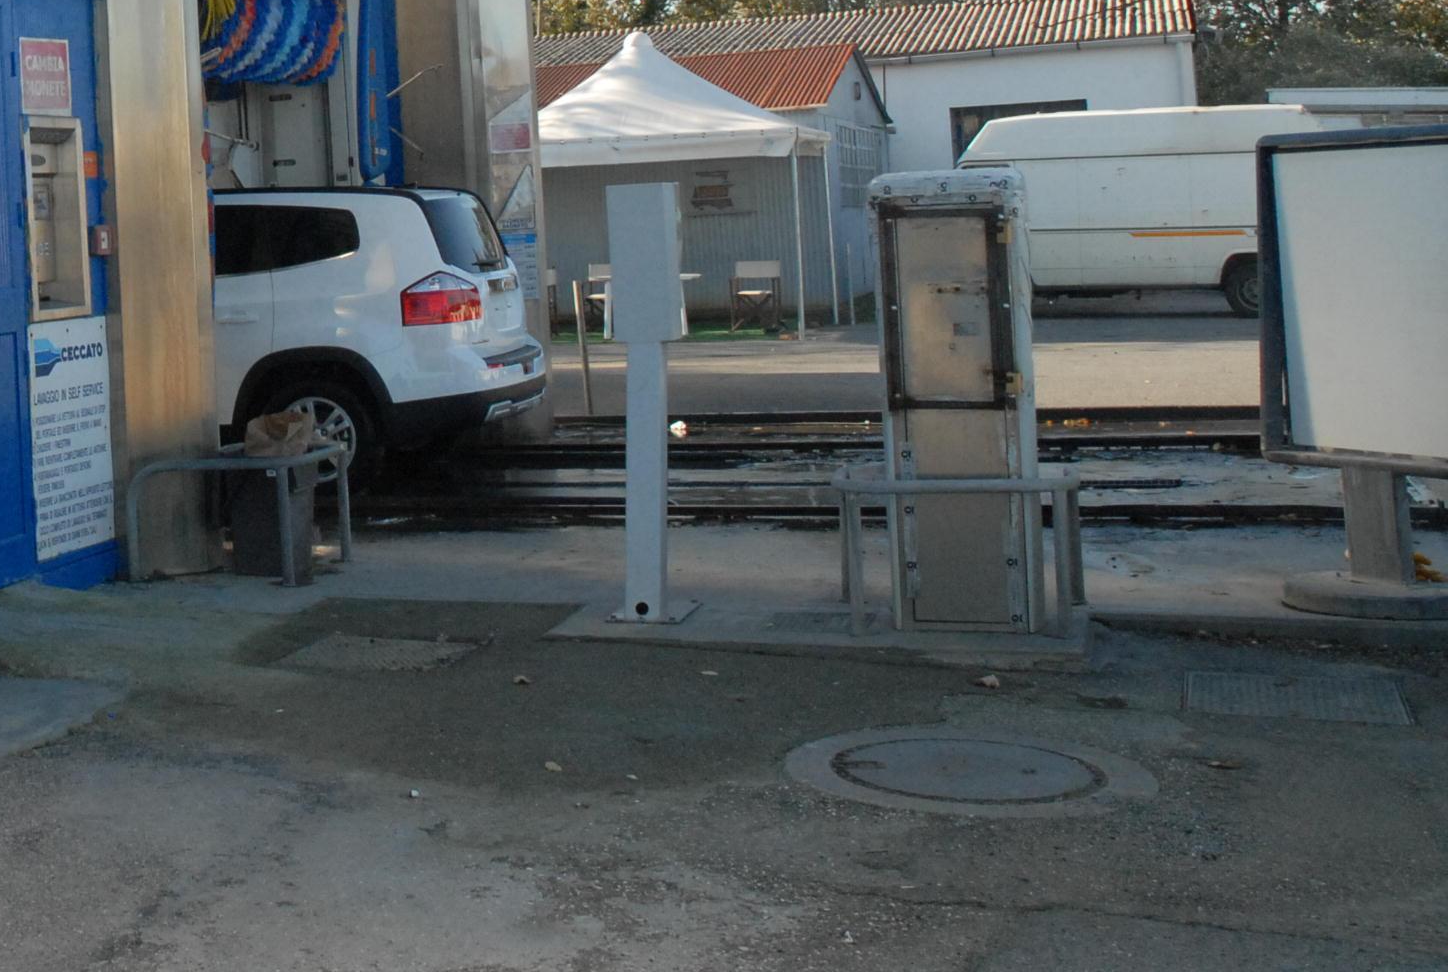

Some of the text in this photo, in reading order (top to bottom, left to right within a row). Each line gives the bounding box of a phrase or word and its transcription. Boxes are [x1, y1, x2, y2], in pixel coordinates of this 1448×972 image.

[24, 54, 64, 72] CAMBIA
[60, 342, 103, 362] CECCATO
[34, 381, 104, 406] LAVAGGIO IN SELF SERVICE
